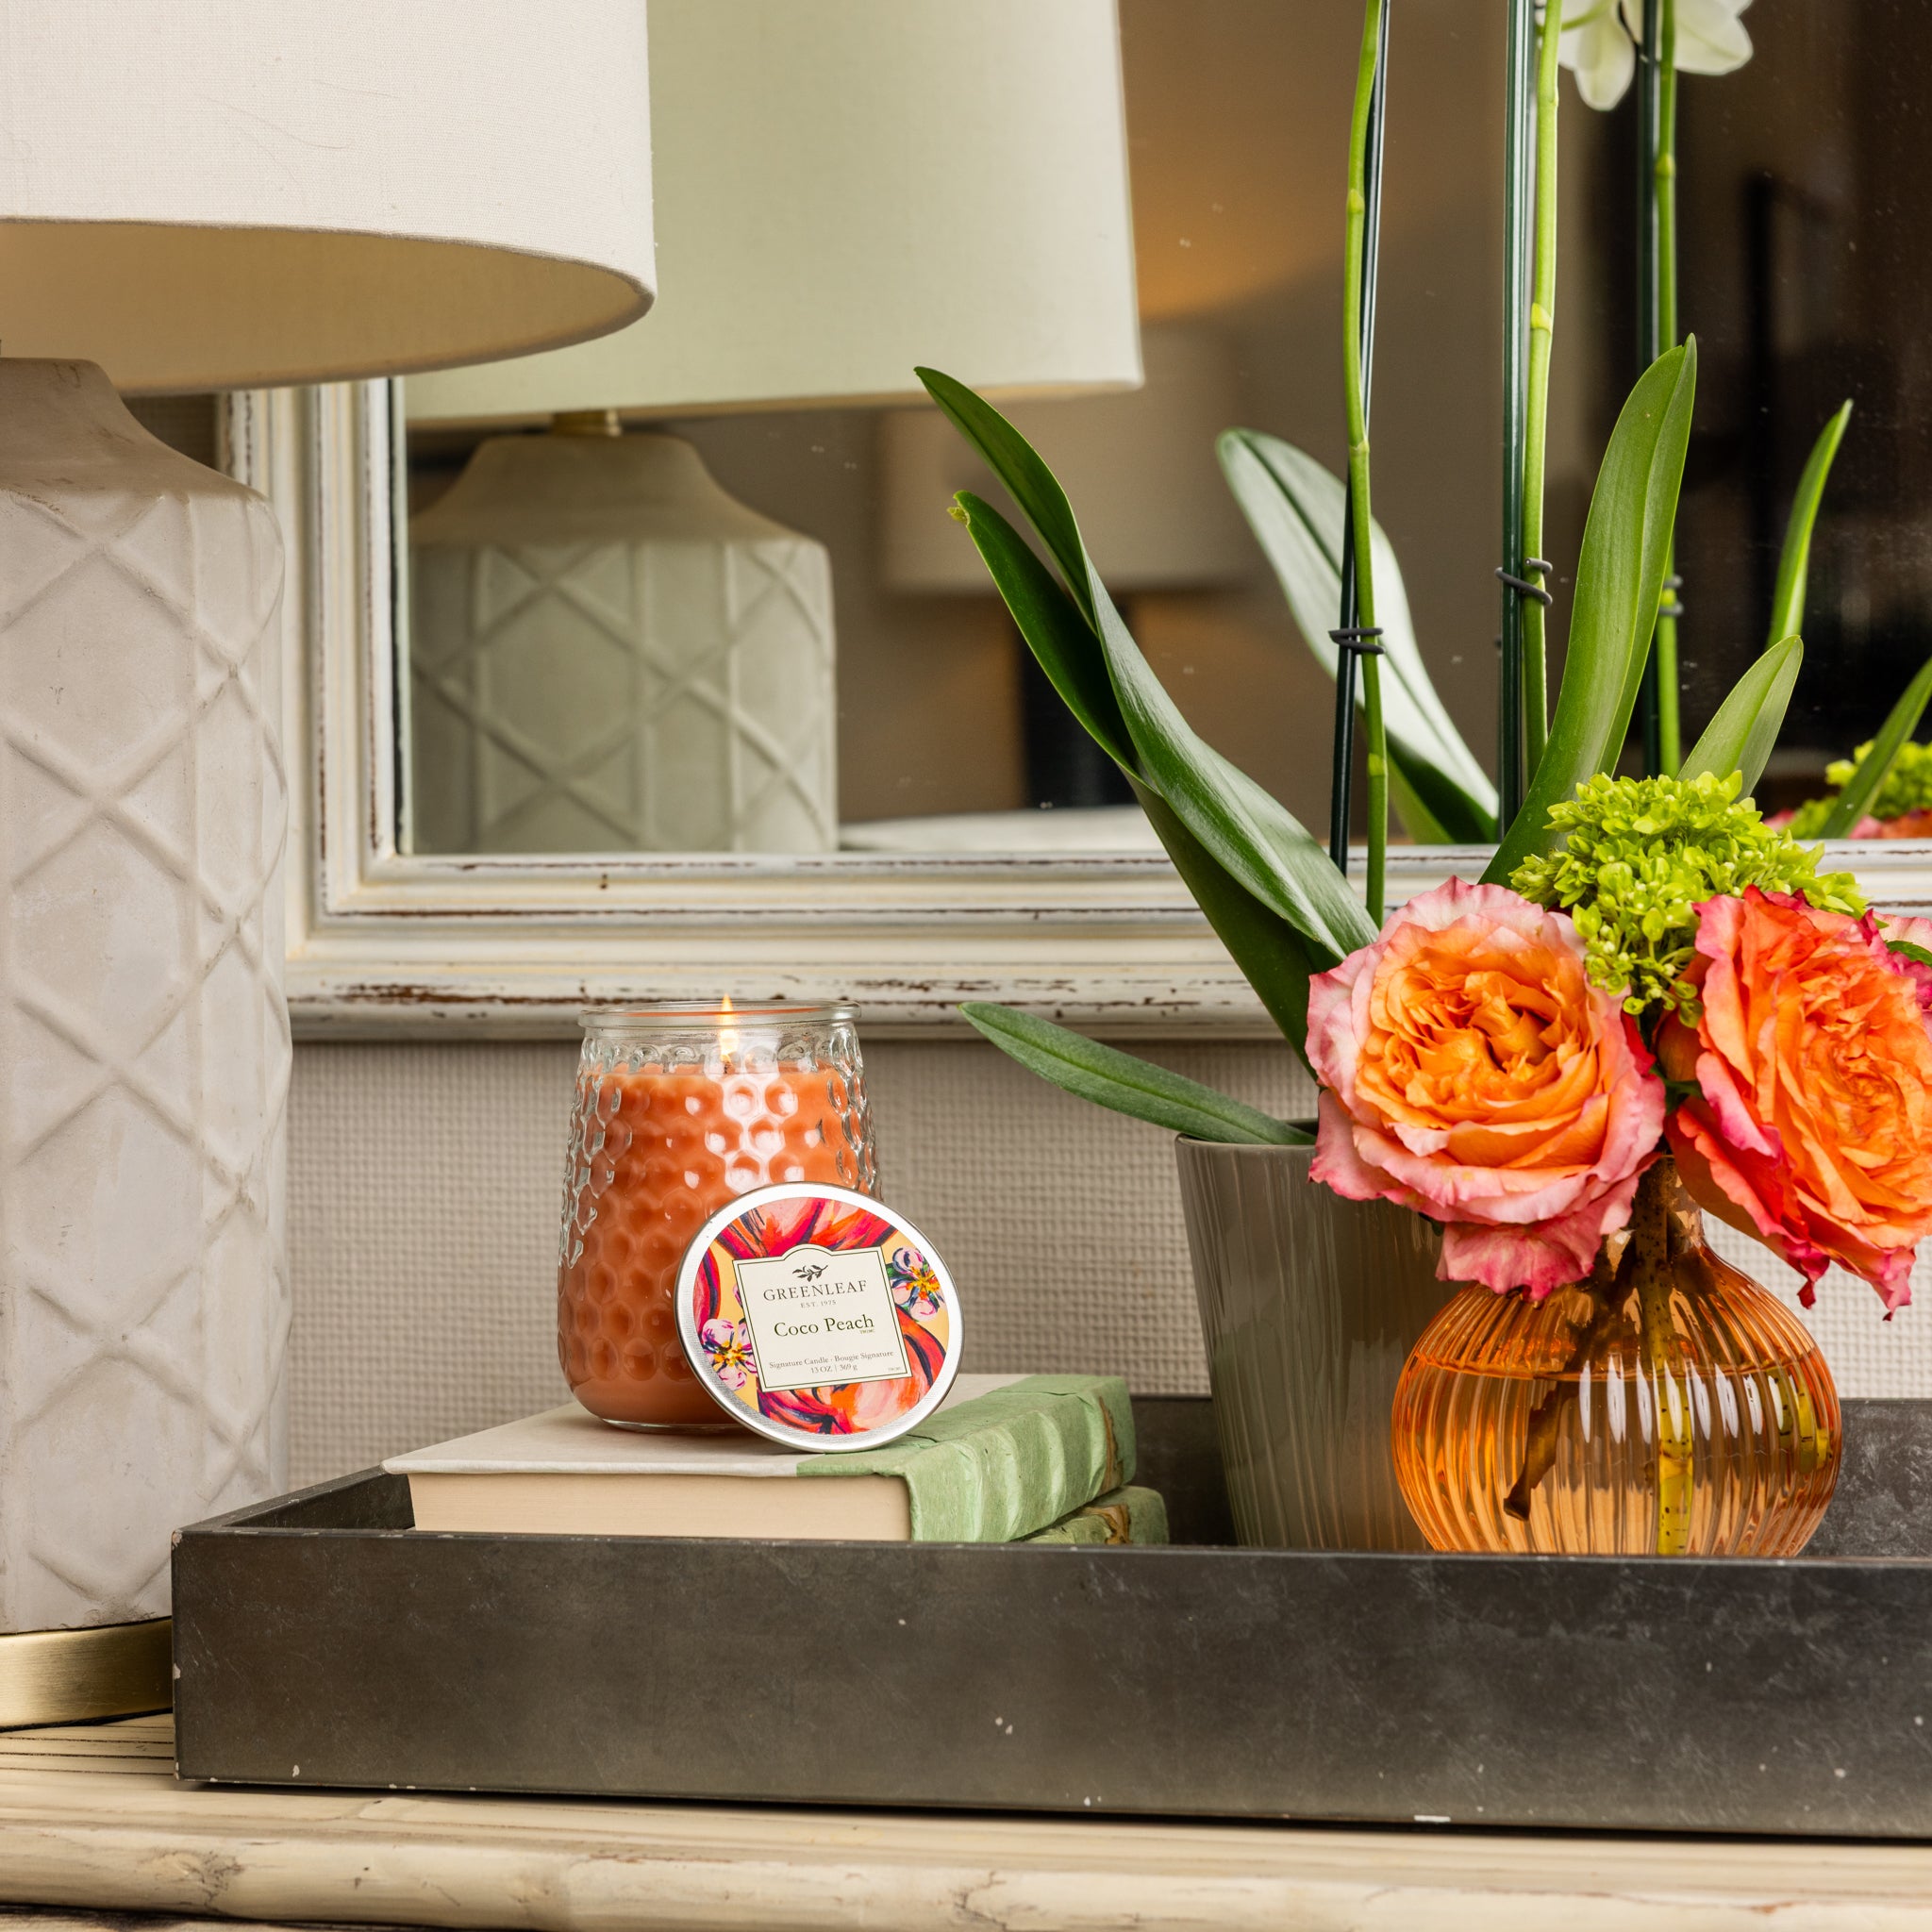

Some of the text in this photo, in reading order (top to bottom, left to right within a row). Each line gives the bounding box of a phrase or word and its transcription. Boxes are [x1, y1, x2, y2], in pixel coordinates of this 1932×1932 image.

[763, 1280, 867, 1301] GREENLEAF
[774, 1314, 874, 1337] Coco Peach
[769, 1359, 803, 1369] Signature
[804, 1357, 829, 1365] Candle
[834, 1354, 859, 1362] Bougie
[859, 1351, 894, 1361] Signature
